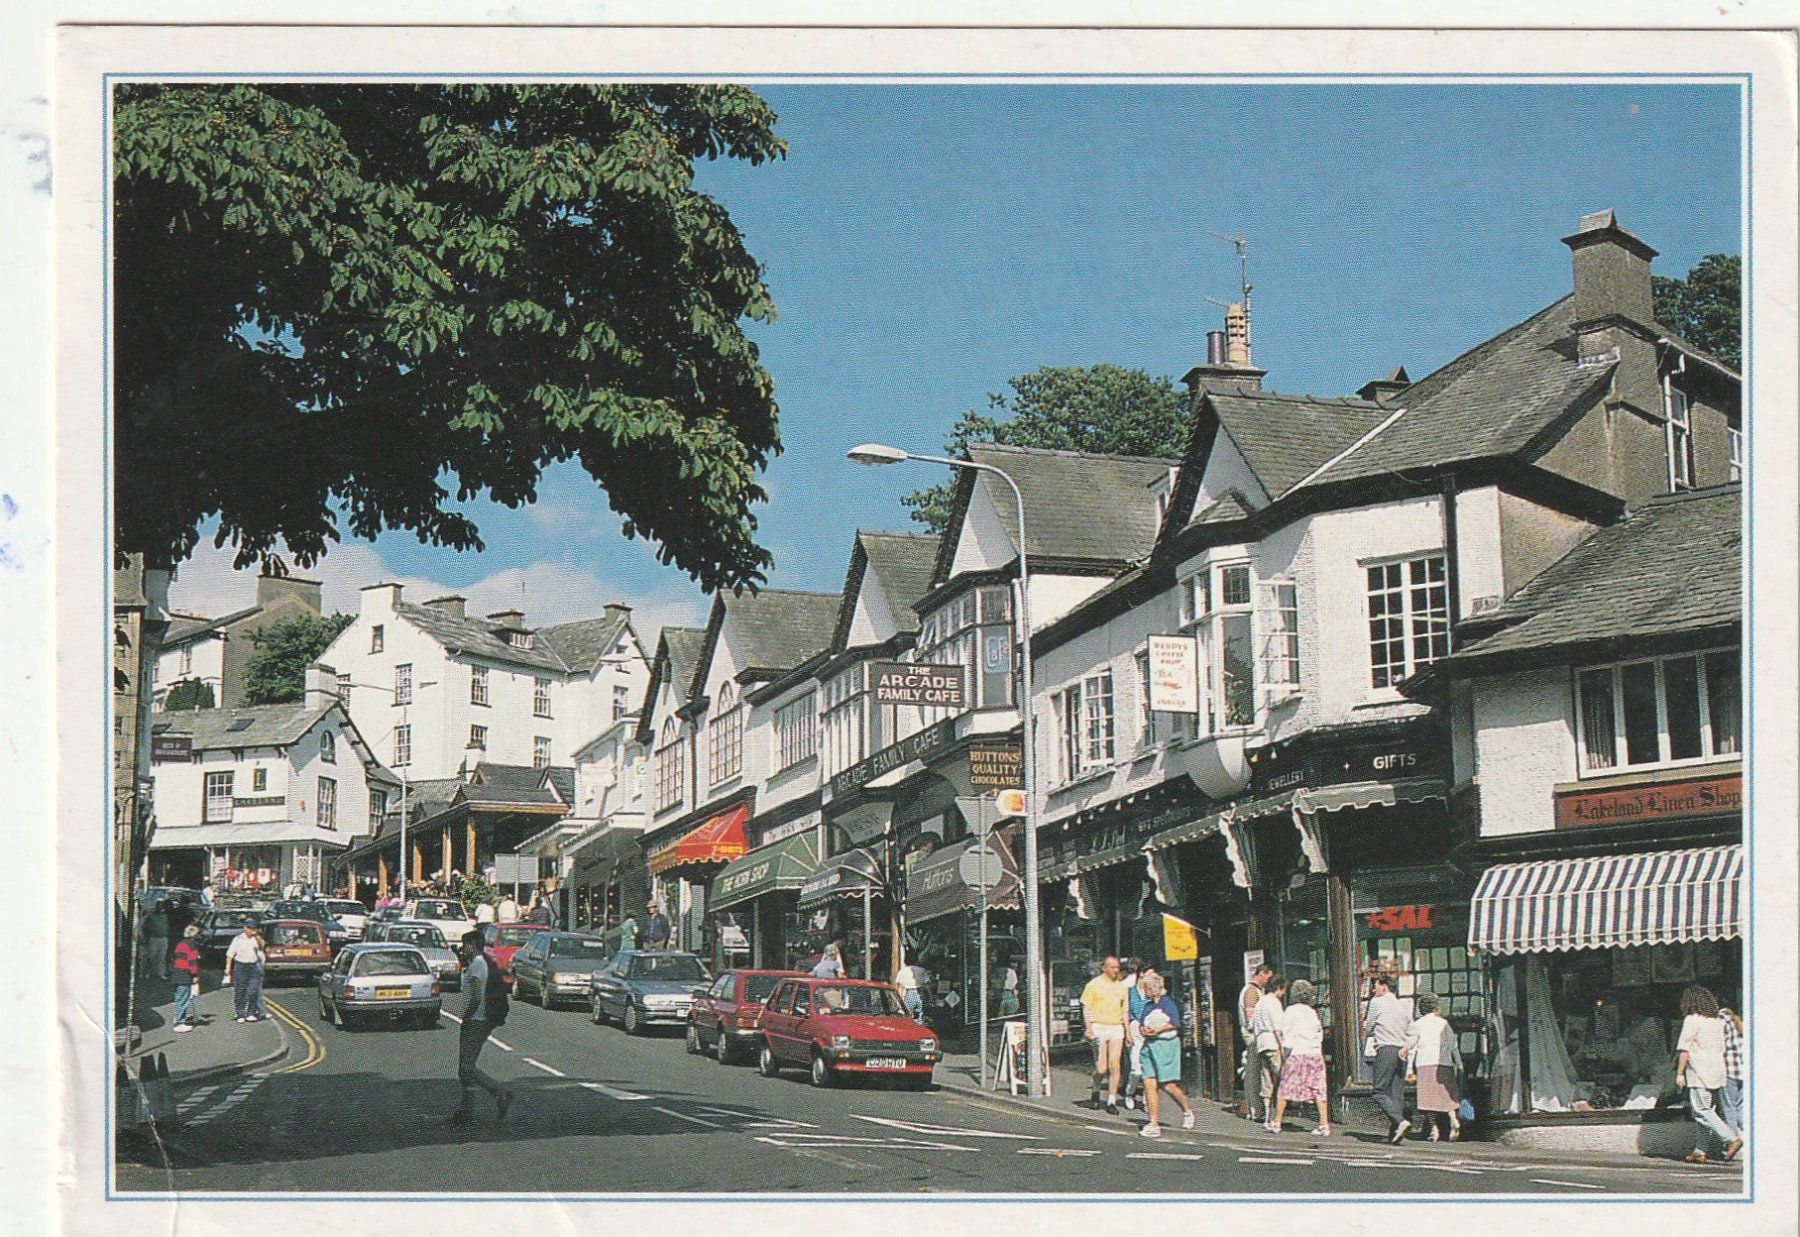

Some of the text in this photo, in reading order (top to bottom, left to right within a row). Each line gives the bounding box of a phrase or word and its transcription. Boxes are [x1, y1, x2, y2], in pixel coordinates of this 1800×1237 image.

[907, 666, 932, 675] THE
[879, 674, 959, 689] ARCADE
[877, 687, 960, 702] FAMILY CAFE
[873, 743, 905, 776] FAMILY
[914, 727, 940, 754] CAFE
[972, 763, 1018, 774] QUALITY
[1373, 753, 1416, 769] GIFTS
[970, 775, 1022, 785] CHOCOLATES
[1574, 784, 1741, 820] Lakeland Linen Shop
